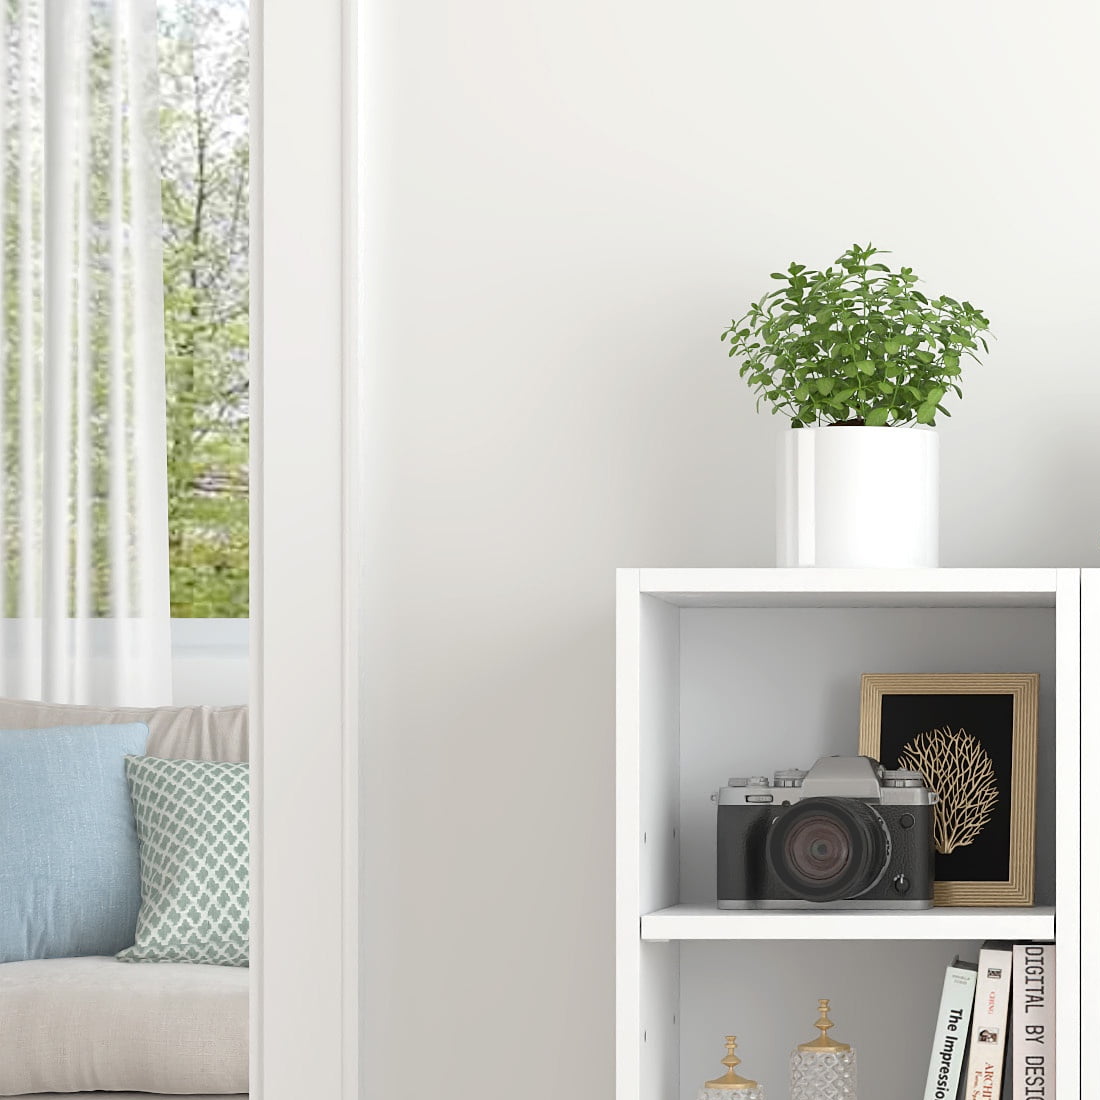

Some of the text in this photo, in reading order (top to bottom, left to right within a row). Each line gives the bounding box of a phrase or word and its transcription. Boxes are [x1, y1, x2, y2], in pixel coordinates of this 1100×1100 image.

[1025, 946, 1045, 1013] DIGITAL
[947, 1008, 963, 1032] The
[1025, 1025, 1045, 1044] BY
